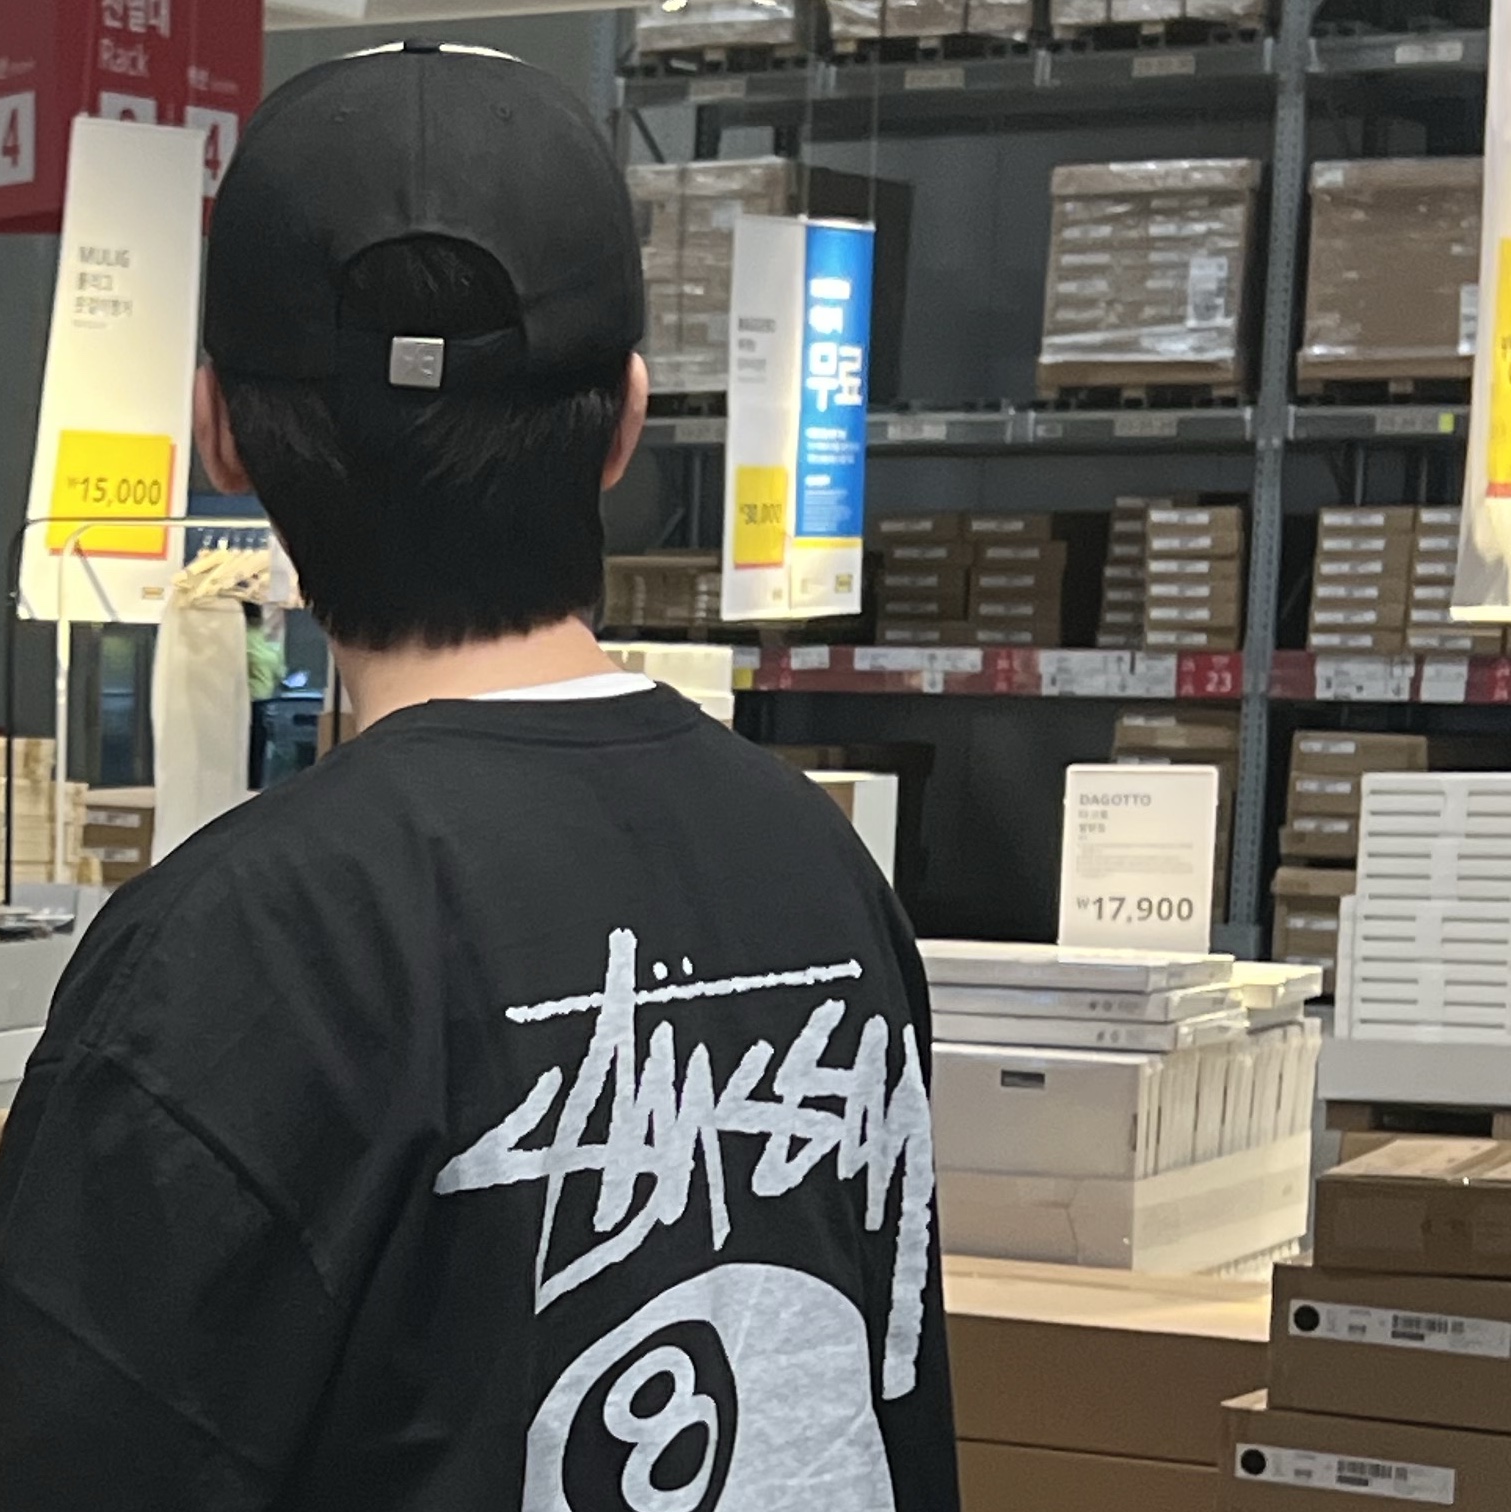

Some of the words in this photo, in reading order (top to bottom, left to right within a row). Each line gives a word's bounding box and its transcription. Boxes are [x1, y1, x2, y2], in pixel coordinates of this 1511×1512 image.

[98, 38, 151, 78] Rack
[1, 106, 22, 169] 4
[204, 123, 222, 181] 4
[805, 341, 864, 413] 무료
[1205, 670, 1232, 693] 23
[1079, 793, 1152, 807] DAGOTTO
